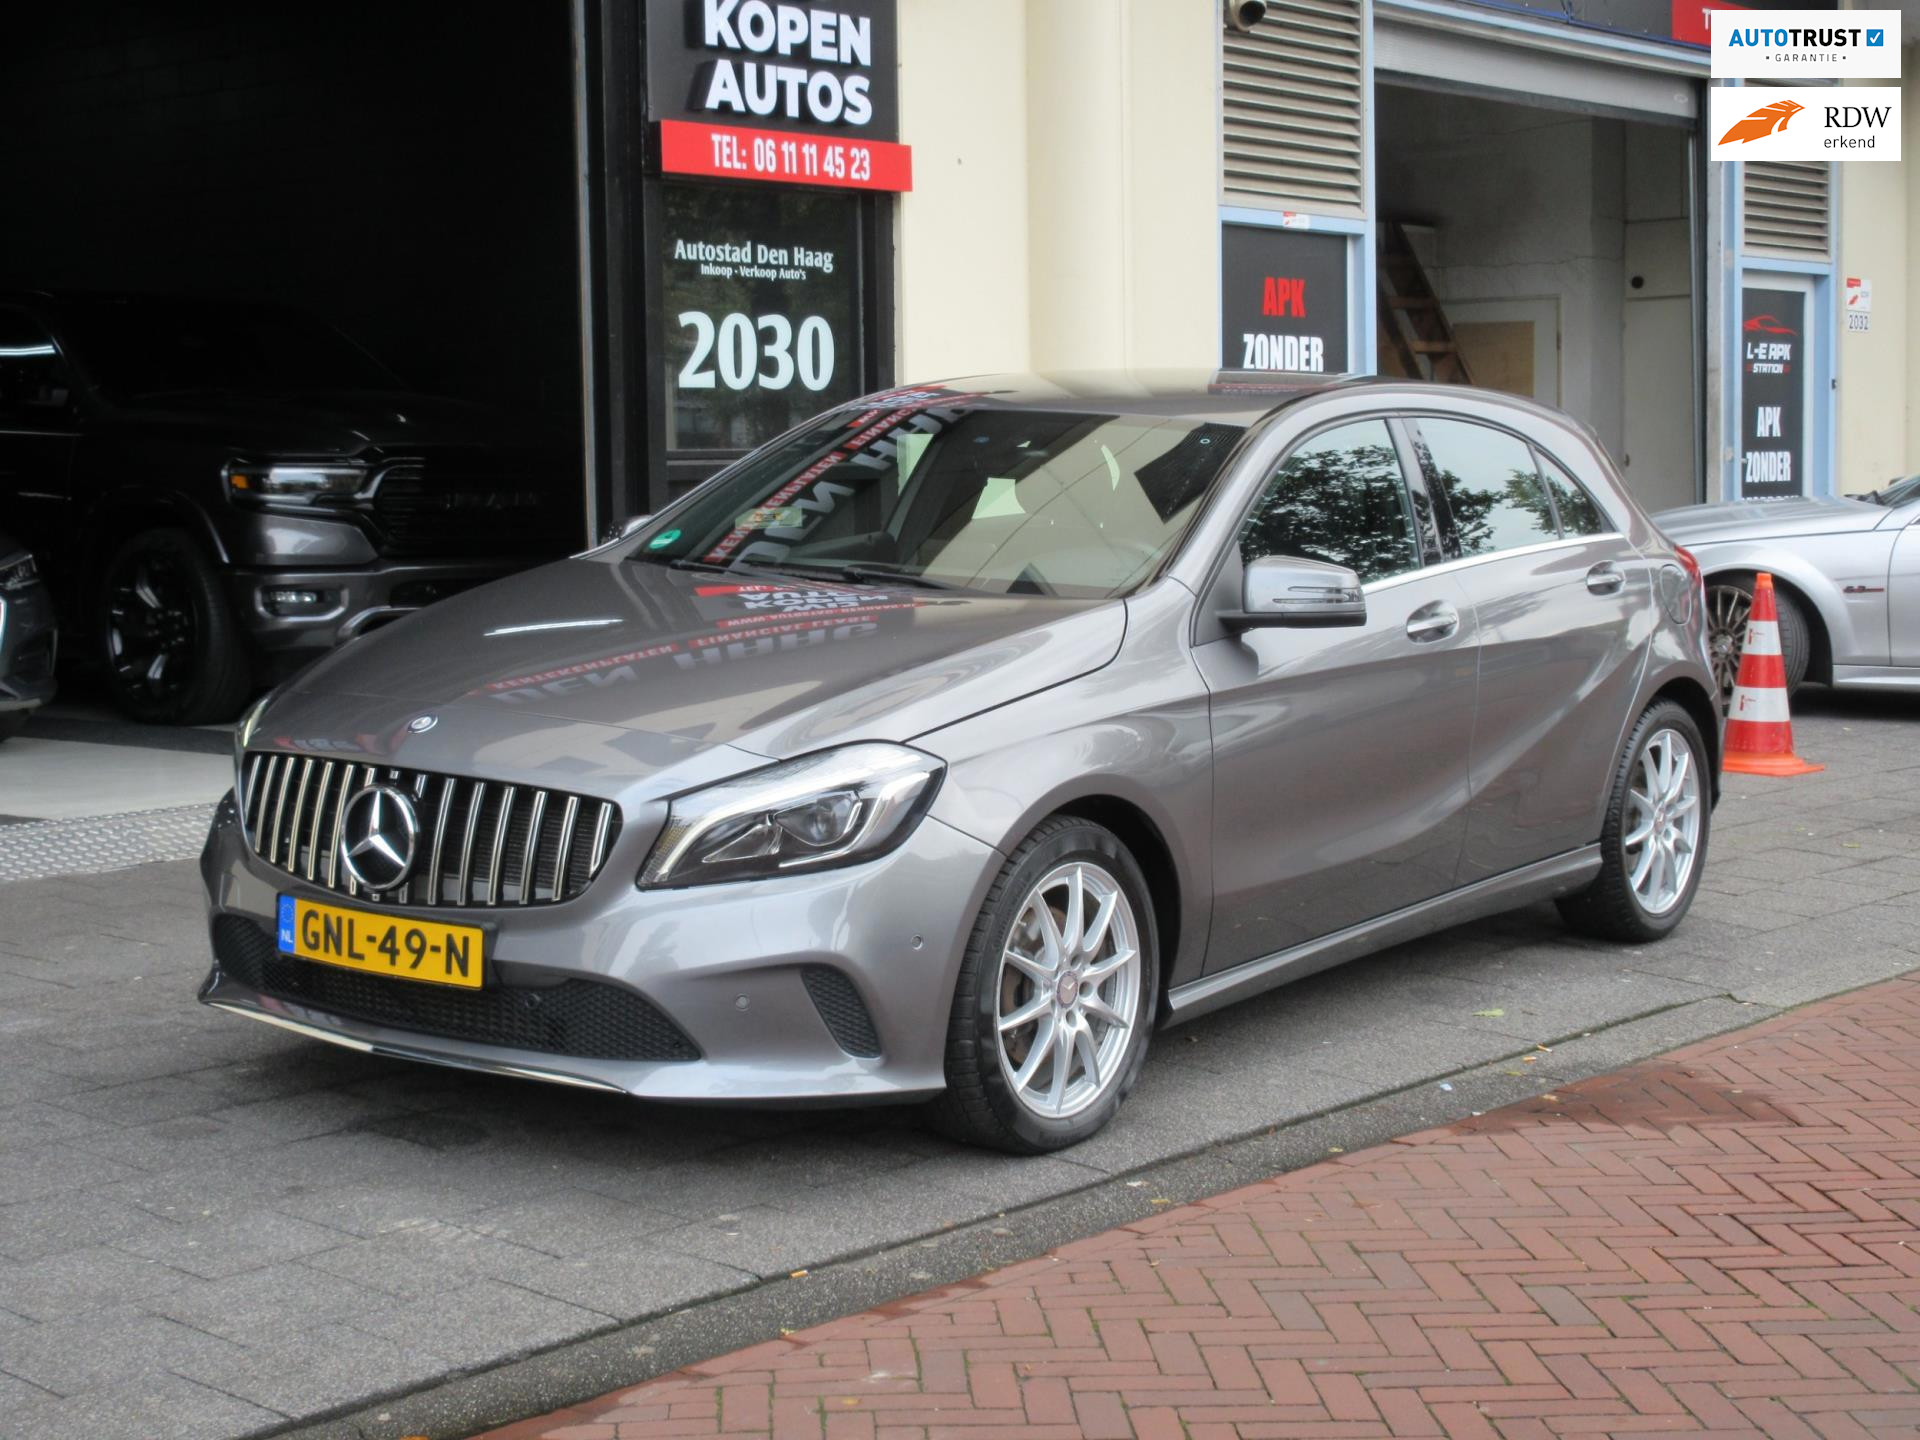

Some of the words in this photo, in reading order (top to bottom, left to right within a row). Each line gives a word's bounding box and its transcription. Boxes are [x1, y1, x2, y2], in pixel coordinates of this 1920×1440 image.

[704, 0, 871, 66] KOPEN
[705, 59, 872, 125] AUTOS
[711, 133, 746, 169] TEL:
[753, 137, 776, 173] 06
[781, 142, 798, 175] 11
[802, 144, 818, 176] 11
[823, 145, 844, 180] 45
[850, 148, 871, 181] 23
[674, 239, 751, 263] Autostad
[757, 244, 788, 265] Den
[794, 247, 833, 273] Haag
[701, 263, 733, 279] Inkoop
[739, 265, 777, 281] Verkoop
[779, 269, 806, 280] Auto's
[1263, 276, 1306, 318] APK
[678, 311, 835, 391] 2030
[1243, 333, 1324, 373] ZONDER
[1753, 363, 1783, 374] STATION
[1756, 407, 1781, 438] APK
[1745, 451, 1791, 483] ZONDER
[280, 929, 294, 943] NL
[302, 909, 470, 978] GNL-49-N
